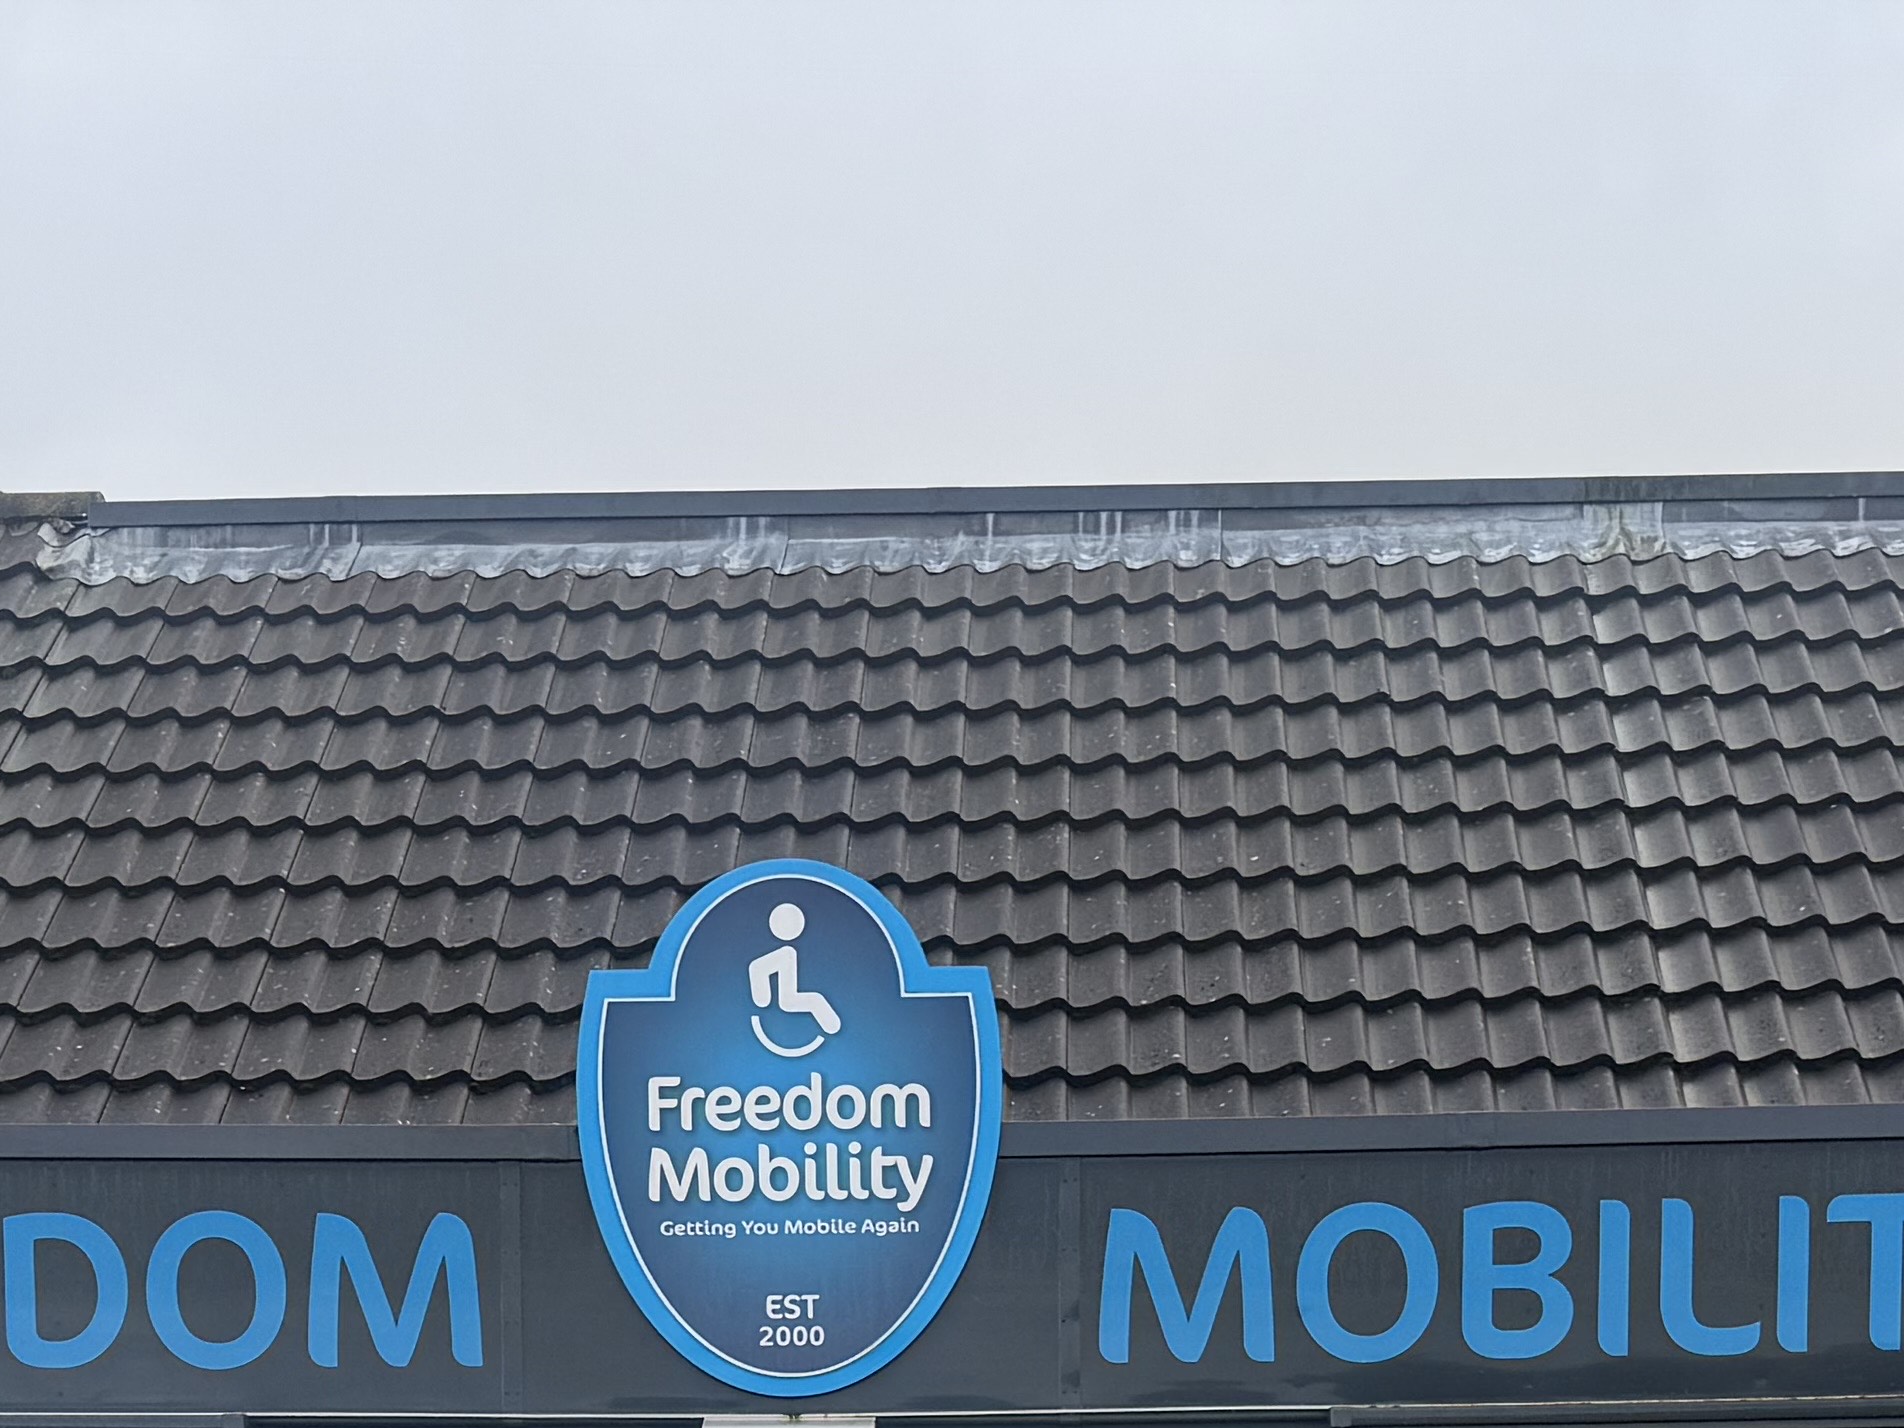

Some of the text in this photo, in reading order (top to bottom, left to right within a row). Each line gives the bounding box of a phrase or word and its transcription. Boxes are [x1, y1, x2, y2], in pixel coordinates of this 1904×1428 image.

[648, 1072, 930, 1131] Freedom
[649, 1143, 933, 1211] Mobility
[660, 1217, 919, 1238] Getting You Mobile Again
[766, 1295, 819, 1319] EST
[760, 1326, 824, 1346] 2000
